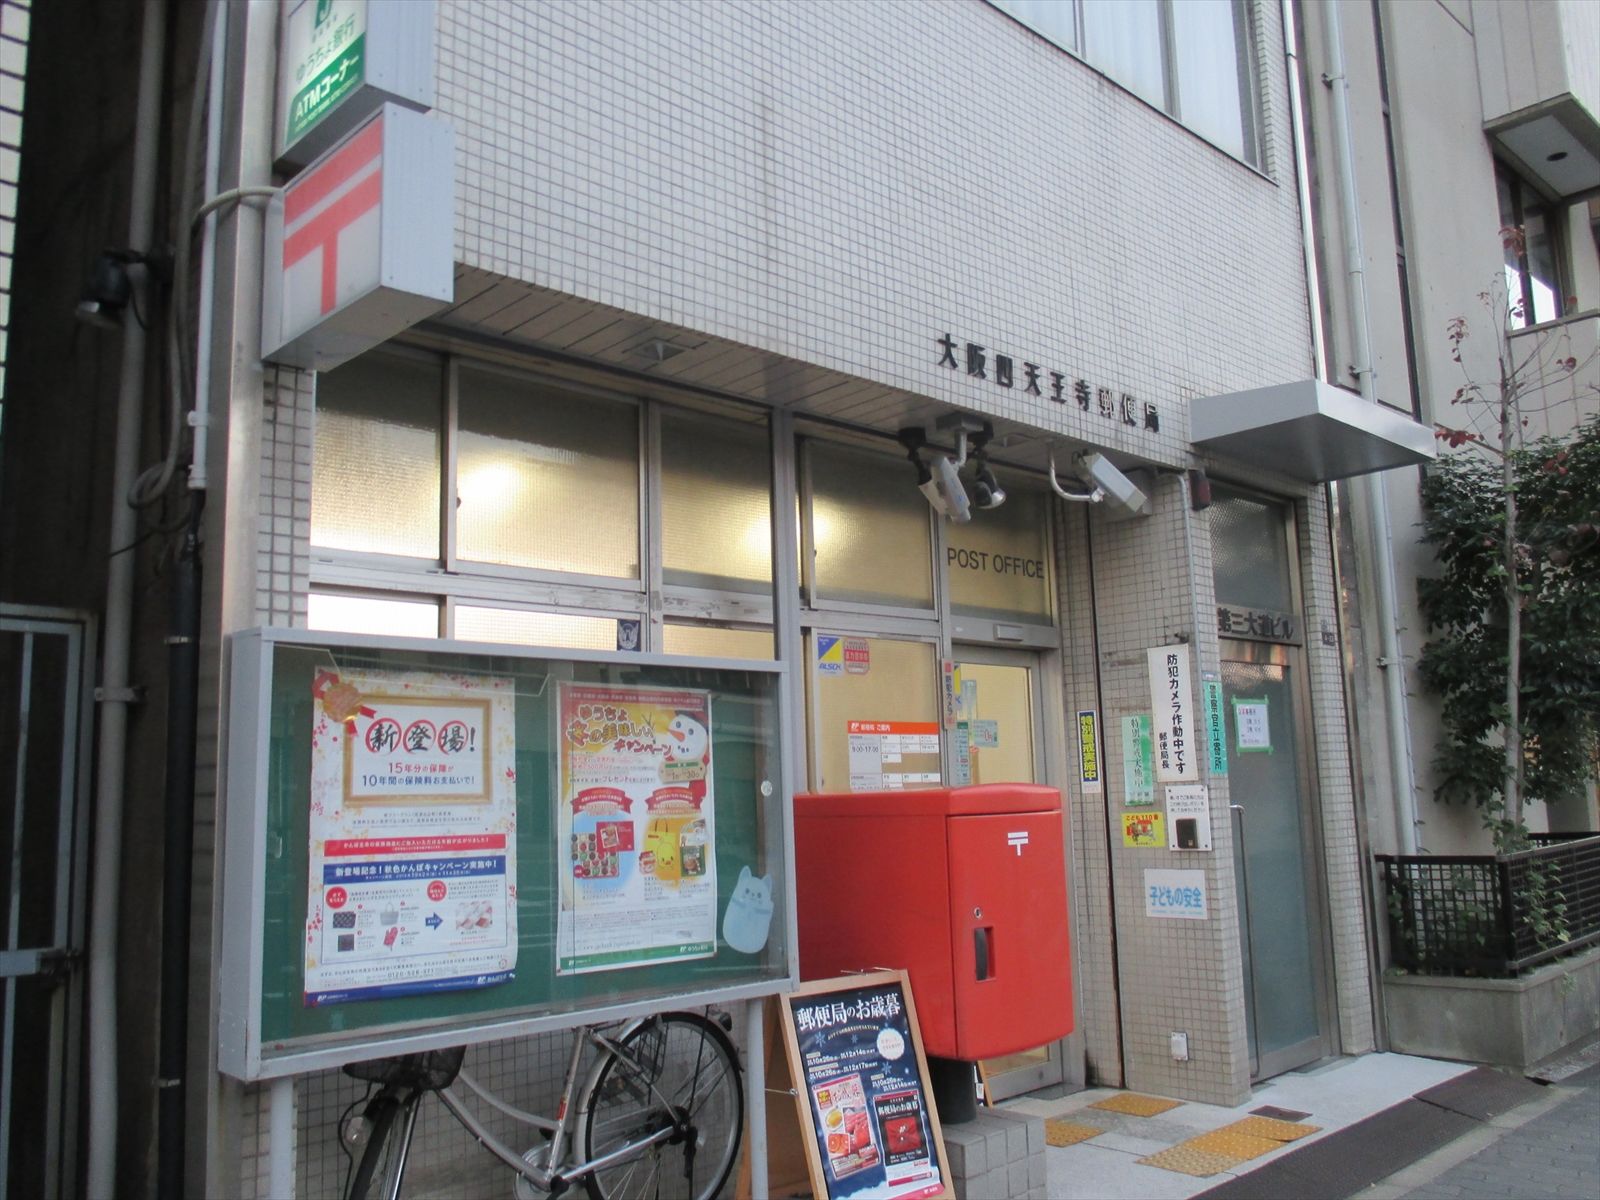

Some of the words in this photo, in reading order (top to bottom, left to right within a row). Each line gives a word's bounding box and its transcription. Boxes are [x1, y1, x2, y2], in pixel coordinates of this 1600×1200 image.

[295, 55, 360, 122] ATMコーナー
[937, 333, 1160, 433] 大阪四天王寺郵便局
[947, 547, 989, 571] POST
[993, 554, 1045, 580] OFFICE
[1167, 653, 1186, 775] 防犯カメラ作動中です
[1159, 732, 1170, 769] 郵便局長
[1149, 886, 1204, 909] 子どもの安全
[797, 993, 901, 1031] 郵便局のお歳暮
